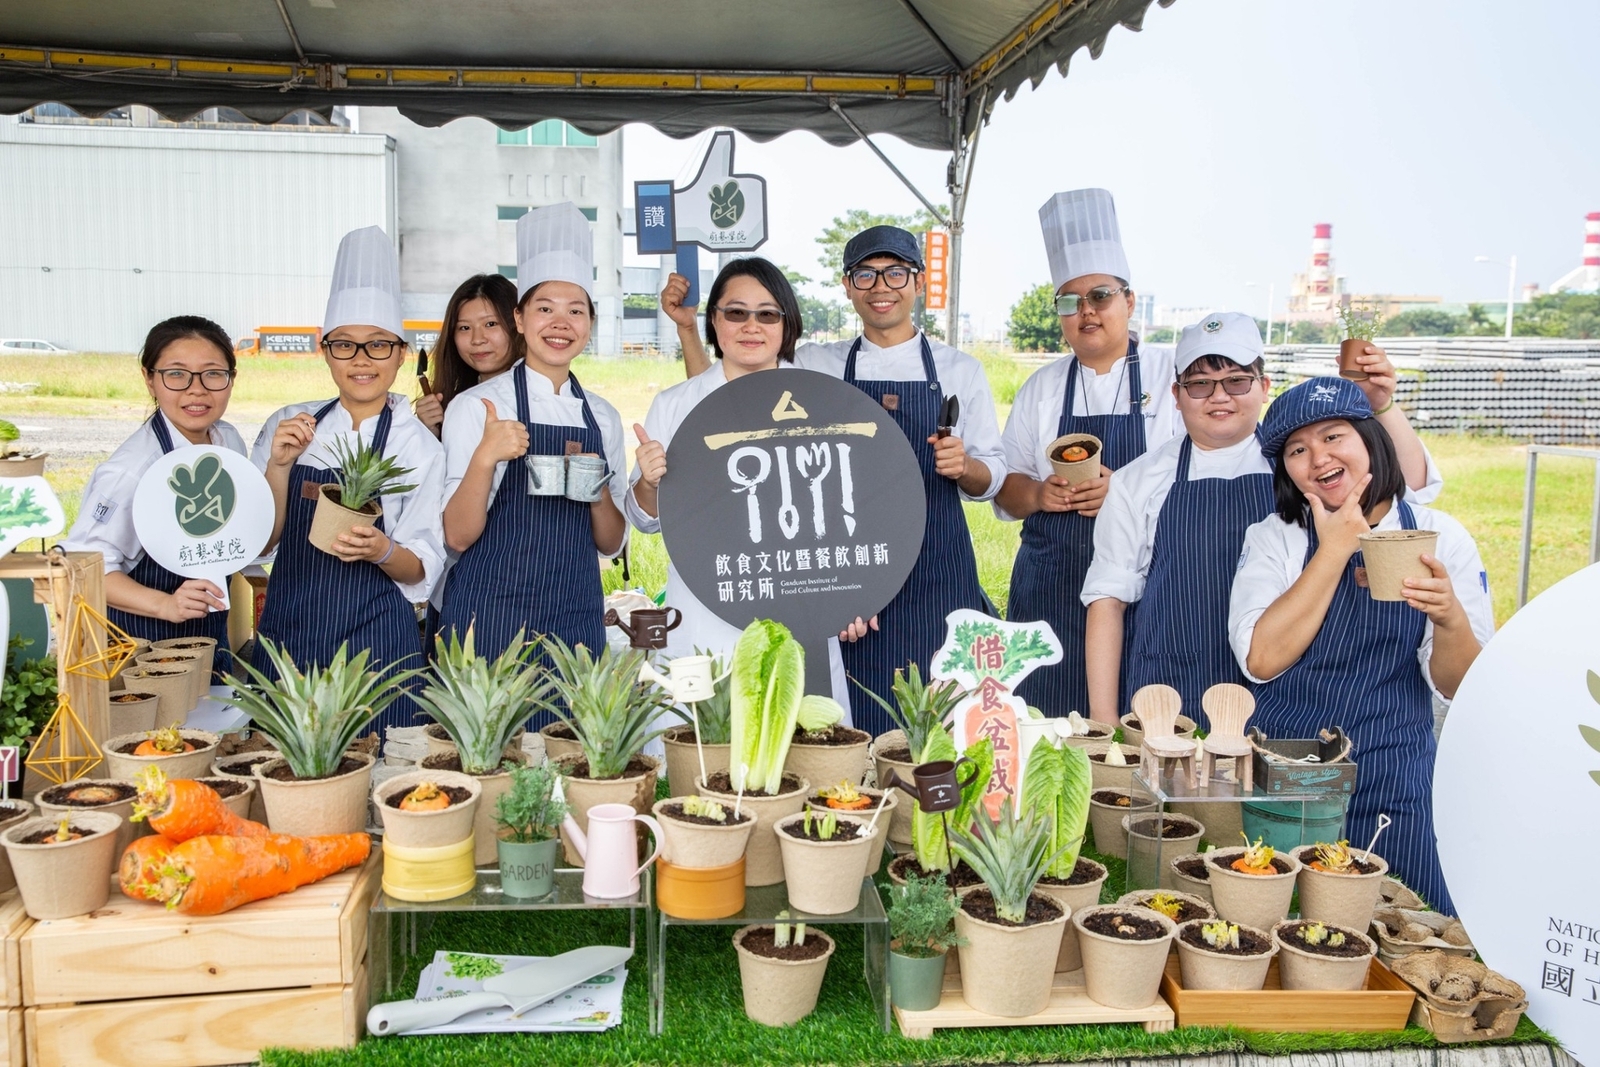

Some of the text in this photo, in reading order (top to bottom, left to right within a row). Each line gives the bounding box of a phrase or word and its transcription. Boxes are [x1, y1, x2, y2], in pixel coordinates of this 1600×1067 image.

[644, 205, 666, 228] 讚
[266, 335, 310, 343] KERRY
[715, 543, 889, 577] 飲食文化暨餐飲創新
[717, 577, 775, 603] 研究所
[781, 587, 797, 595] Food
[501, 861, 549, 882] GARDEN
[1546, 938, 1574, 957] OF
